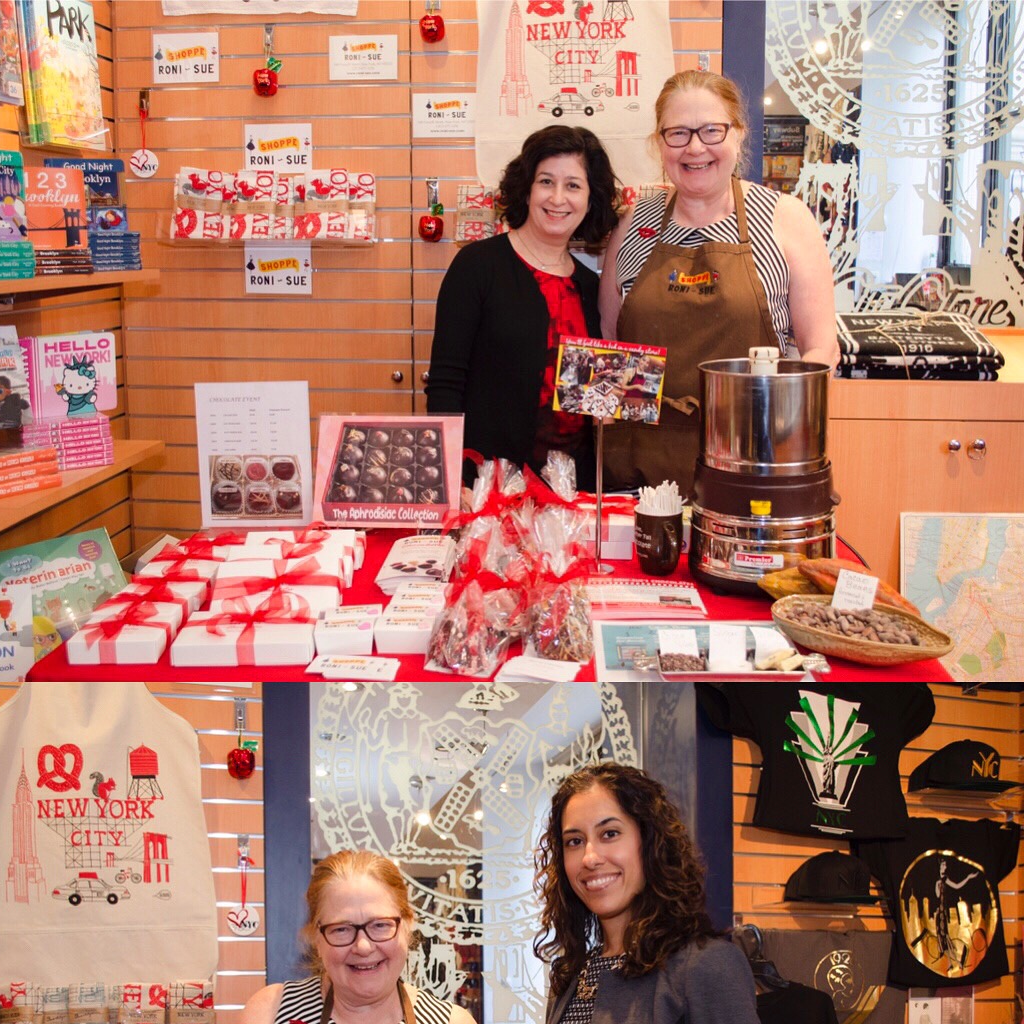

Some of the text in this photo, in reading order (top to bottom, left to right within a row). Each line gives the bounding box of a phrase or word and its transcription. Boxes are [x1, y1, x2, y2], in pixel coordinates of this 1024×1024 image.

[47, 0, 92, 42] PARK
[526, 20, 626, 41] NEW YORK
[166, 47, 206, 61] SHOPPE
[555, 50, 599, 65] CITY
[158, 64, 214, 74] RONI SUE
[883, 83, 947, 103] 1625
[434, 101, 461, 109] SHOPPE
[260, 138, 298, 150] SHOPPE
[63, 162, 113, 171] Good Night
[250, 155, 307, 165] RONI SUE
[37, 172, 67, 188] 2 3
[260, 259, 298, 271] SHOPPE
[250, 276, 307, 286] RONI SUE
[667, 284, 716, 295] RONI SUE
[44, 338, 110, 353] HELLO
[45, 353, 74, 368] NEW
[333, 506, 439, 520] The Aphrodisiac Collection
[971, 751, 999, 779] NYC
[37, 798, 155, 819] NEW YORK
[71, 830, 123, 846] CITY
[239, 918, 260, 930] NYC
